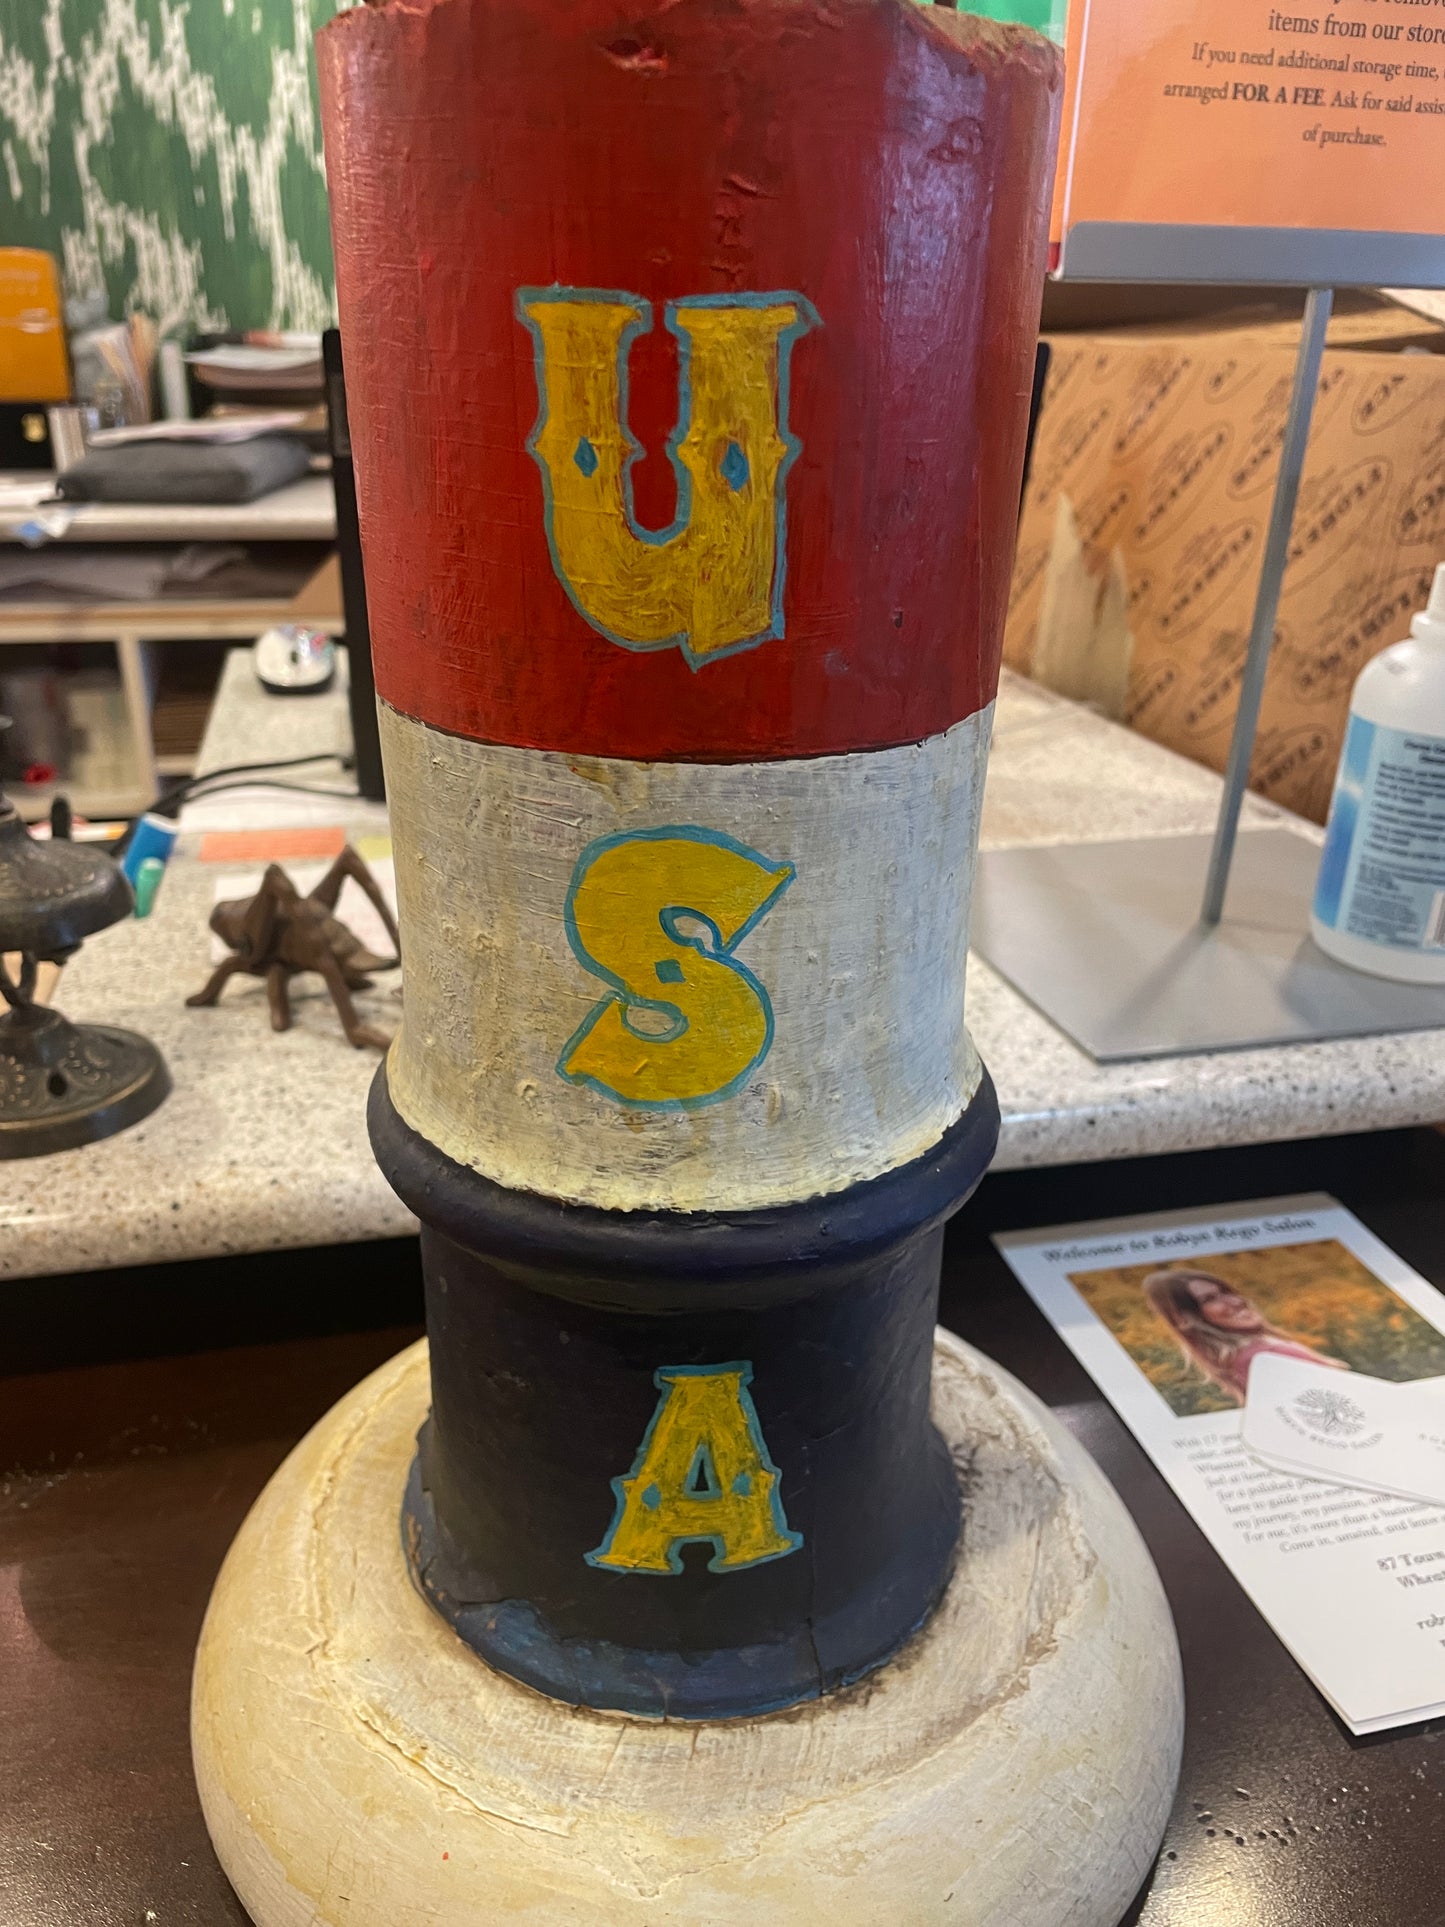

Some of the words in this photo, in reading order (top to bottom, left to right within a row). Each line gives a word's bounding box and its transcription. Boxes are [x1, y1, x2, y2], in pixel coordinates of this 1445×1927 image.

[1268, 9, 1319, 34] items
[1323, 13, 1367, 38] from
[1371, 22, 1404, 41] our
[1191, 42, 1209, 61] If
[1208, 50, 1236, 68] you
[1239, 48, 1274, 66] need
[1278, 49, 1350, 72] additional
[1352, 60, 1401, 81] storage
[1405, 60, 1440, 81] time,
[1163, 81, 1229, 105] arranged
[1231, 82, 1270, 102] FOR
[1274, 86, 1288, 103] A
[1330, 90, 1358, 109] Ask
[1361, 91, 1383, 110] for
[1385, 94, 1413, 112] said
[1303, 123, 1321, 141] of
[1320, 126, 1387, 148] purchase.
[515, 282, 825, 673] U
[555, 824, 797, 1113] S
[1042, 1240, 1125, 1262] Welcome
[1130, 1239, 1149, 1250] to
[583, 1360, 804, 1575] A
